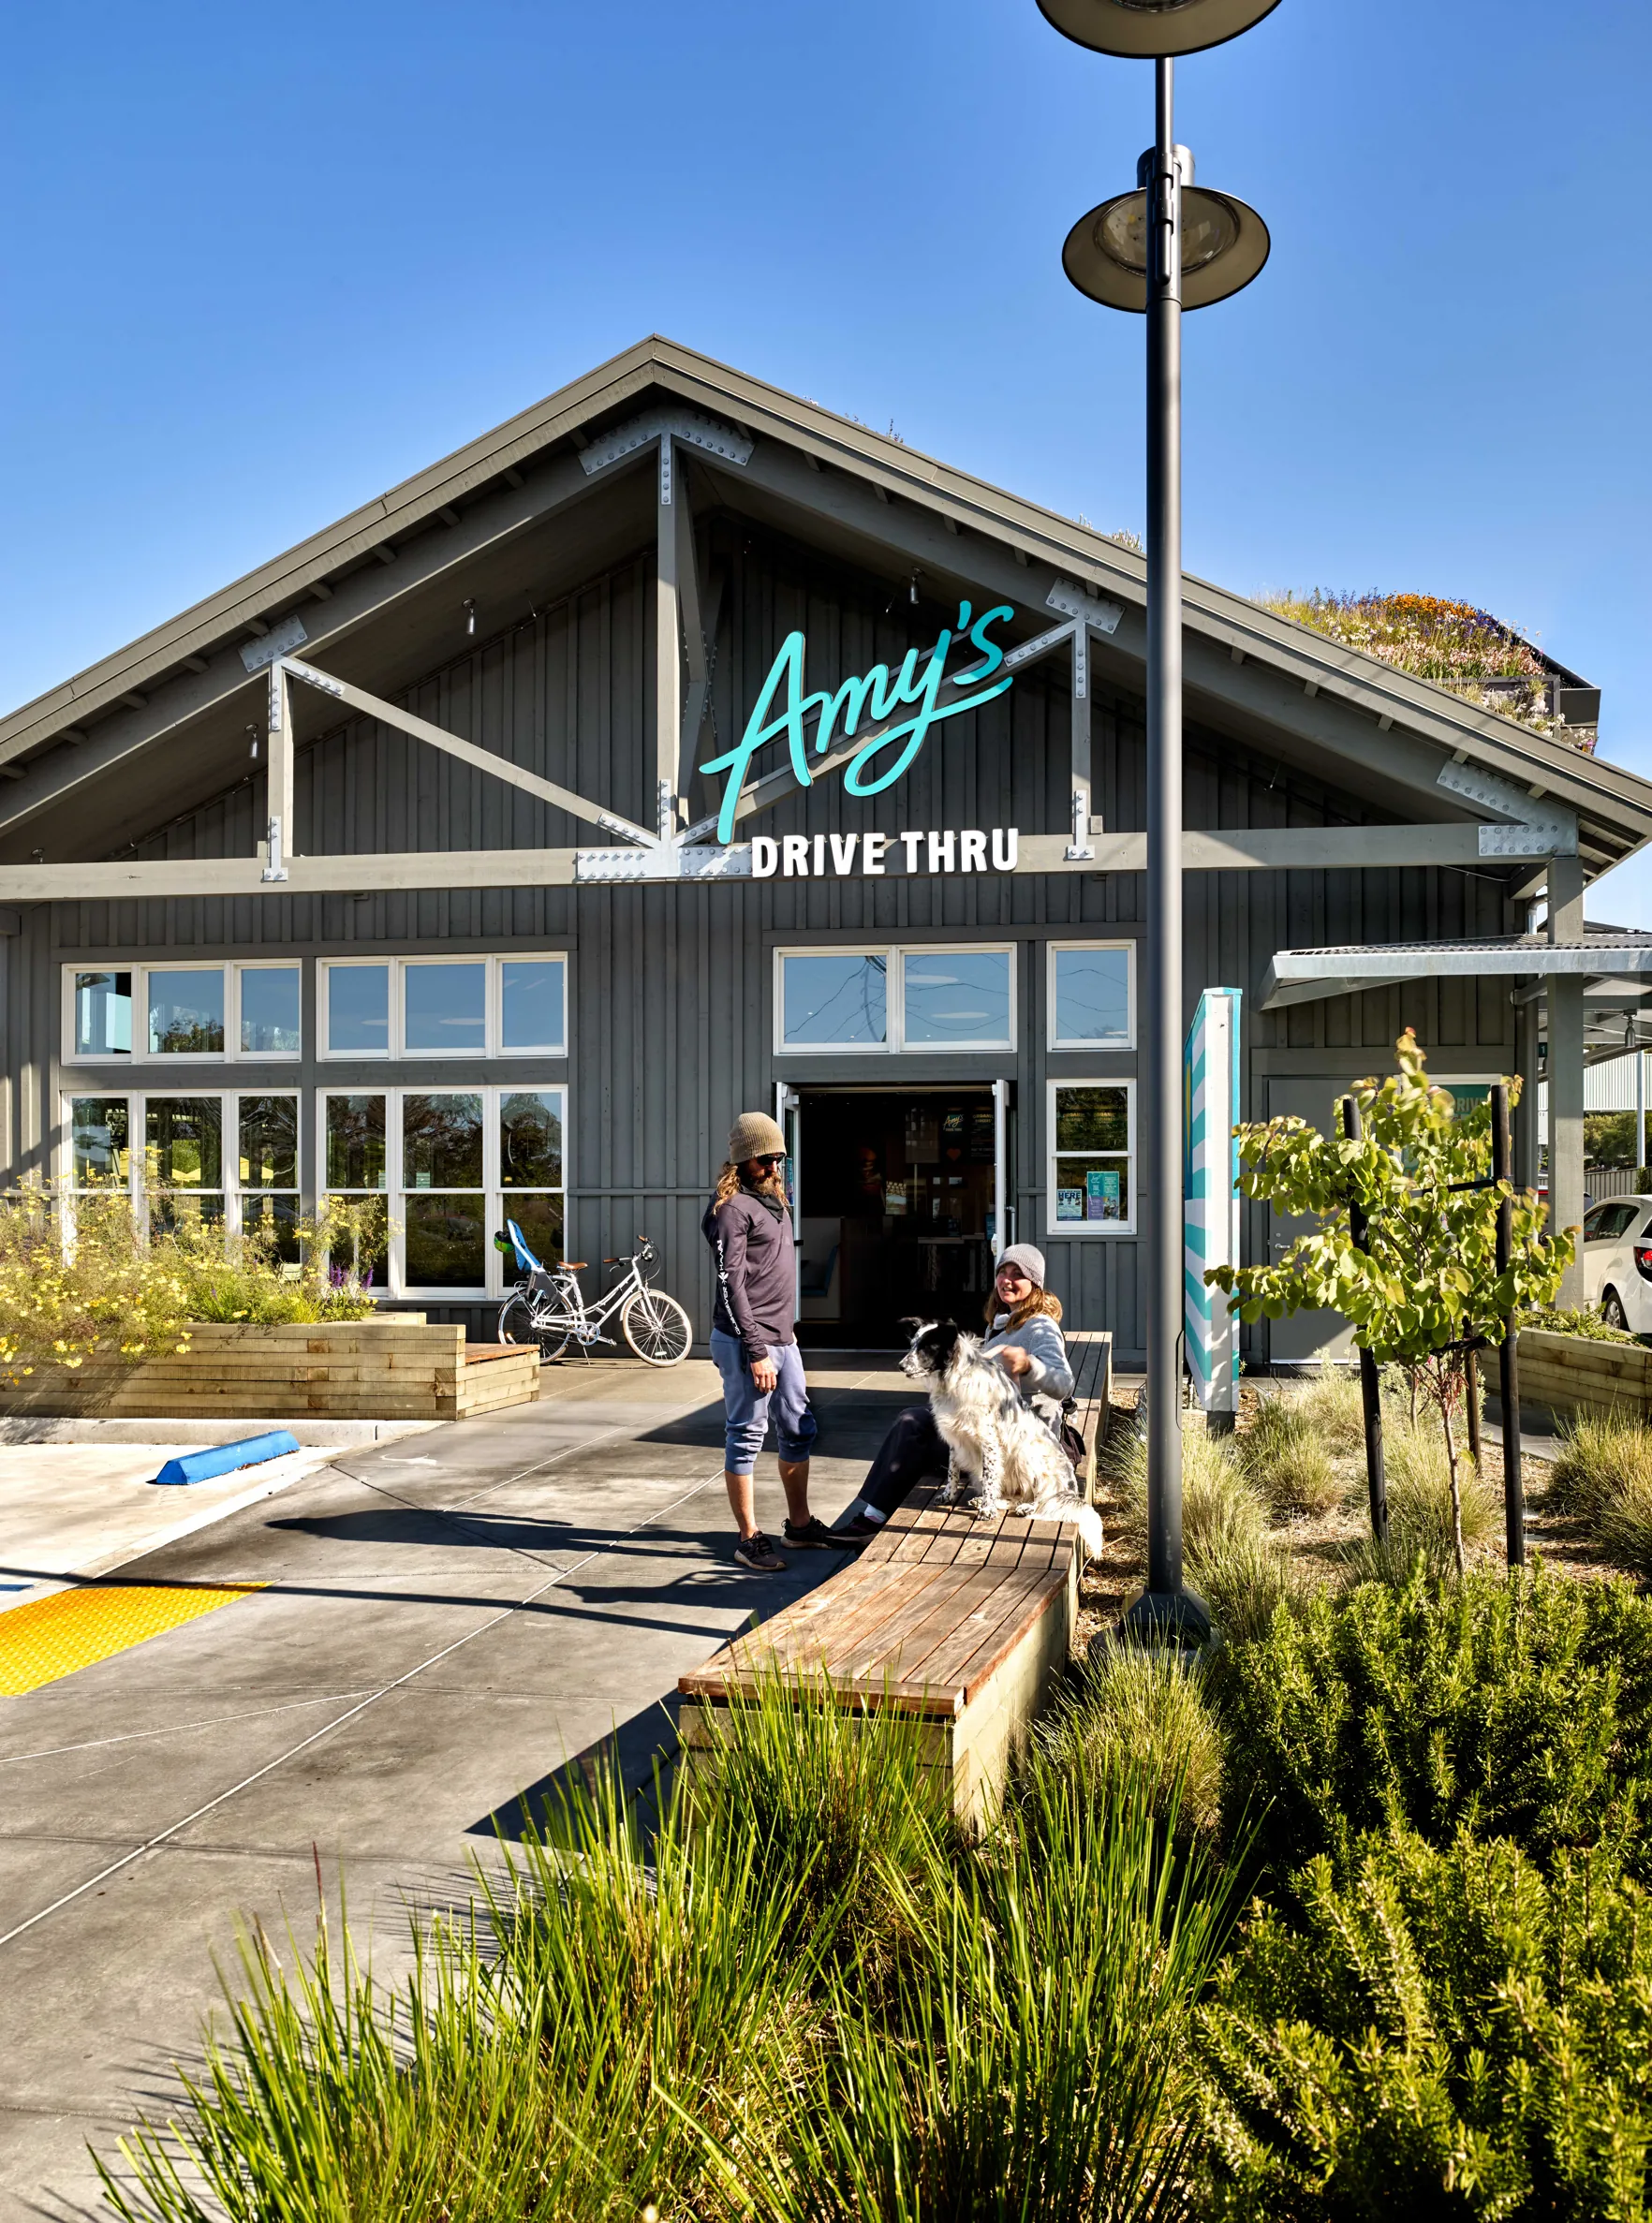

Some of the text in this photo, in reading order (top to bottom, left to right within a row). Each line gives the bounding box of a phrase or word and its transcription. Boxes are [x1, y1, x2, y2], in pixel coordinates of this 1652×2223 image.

[699, 599, 1014, 845] Amy's
[751, 827, 1019, 878] DRIVE THRU
[941, 1113, 965, 1131] Amy's
